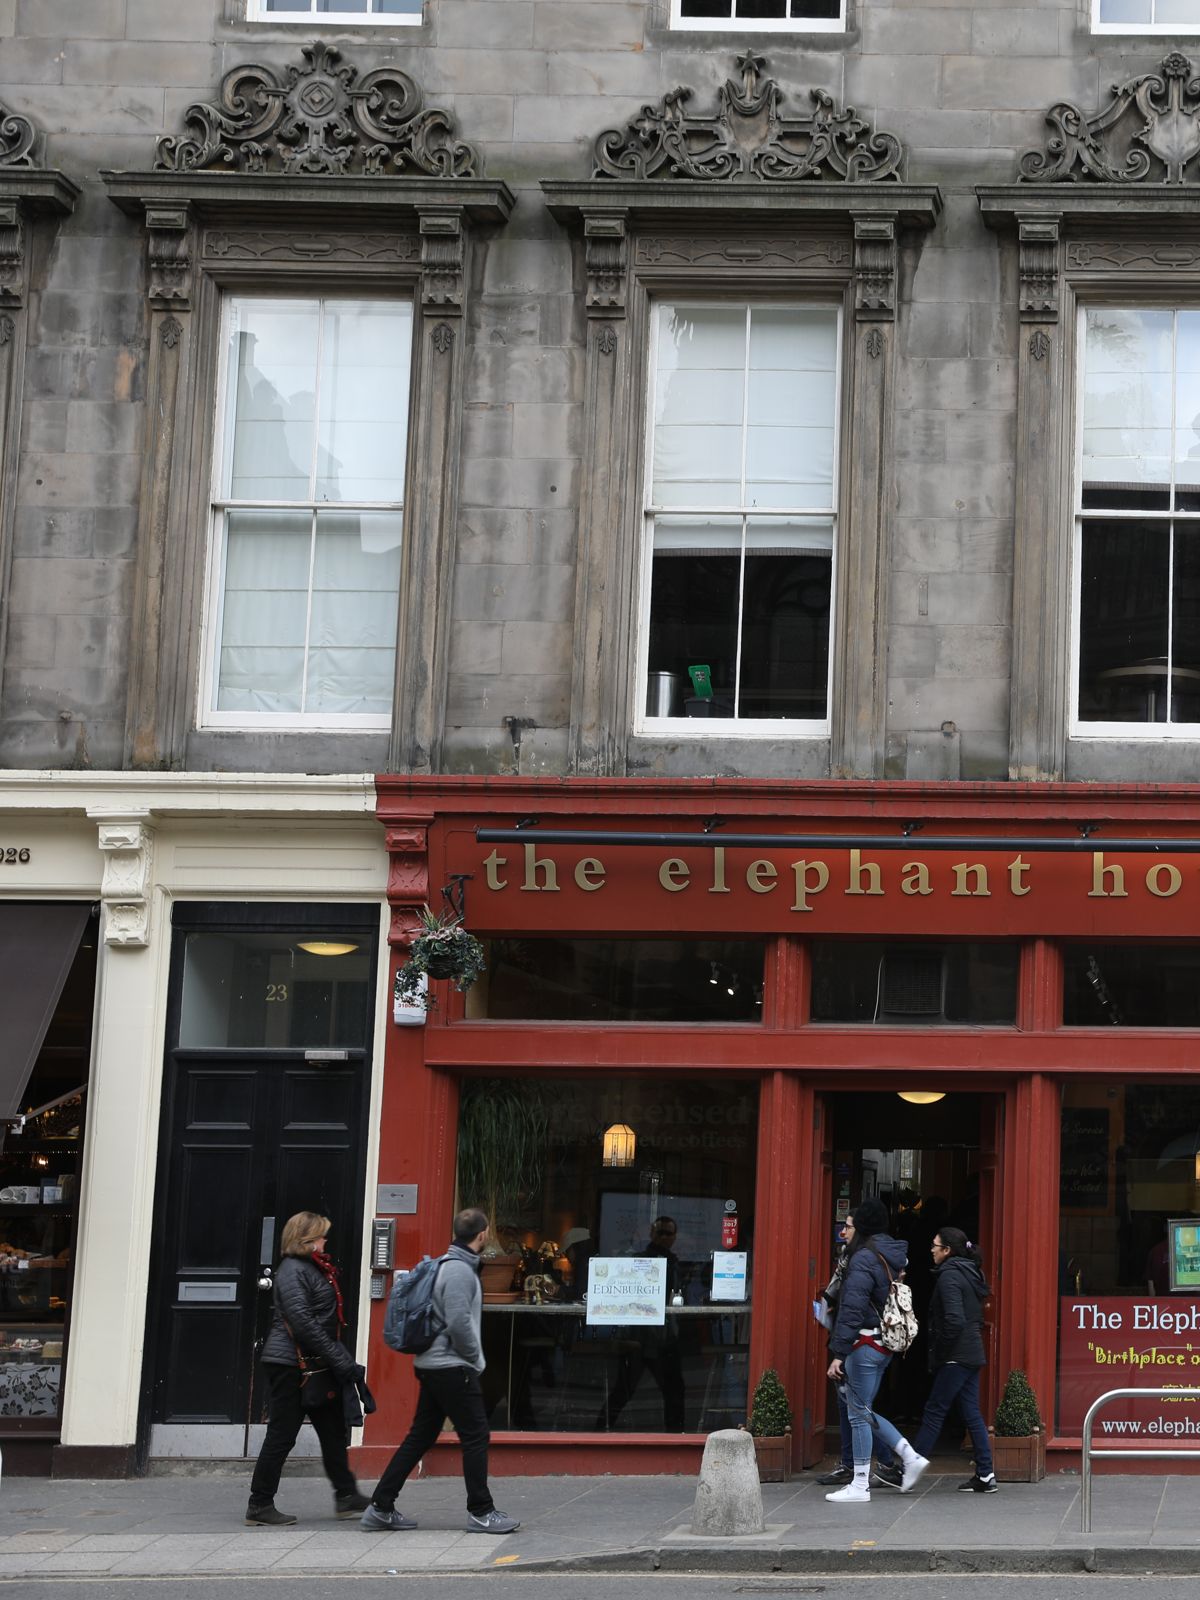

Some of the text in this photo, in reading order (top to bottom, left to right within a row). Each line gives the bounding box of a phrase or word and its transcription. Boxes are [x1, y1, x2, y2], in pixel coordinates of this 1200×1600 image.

[483, 843, 606, 892] the
[659, 847, 1031, 912] elephant
[265, 984, 288, 1001] 23
[593, 1284, 661, 1295] EDINBURGH
[1072, 1304, 1122, 1330] The
